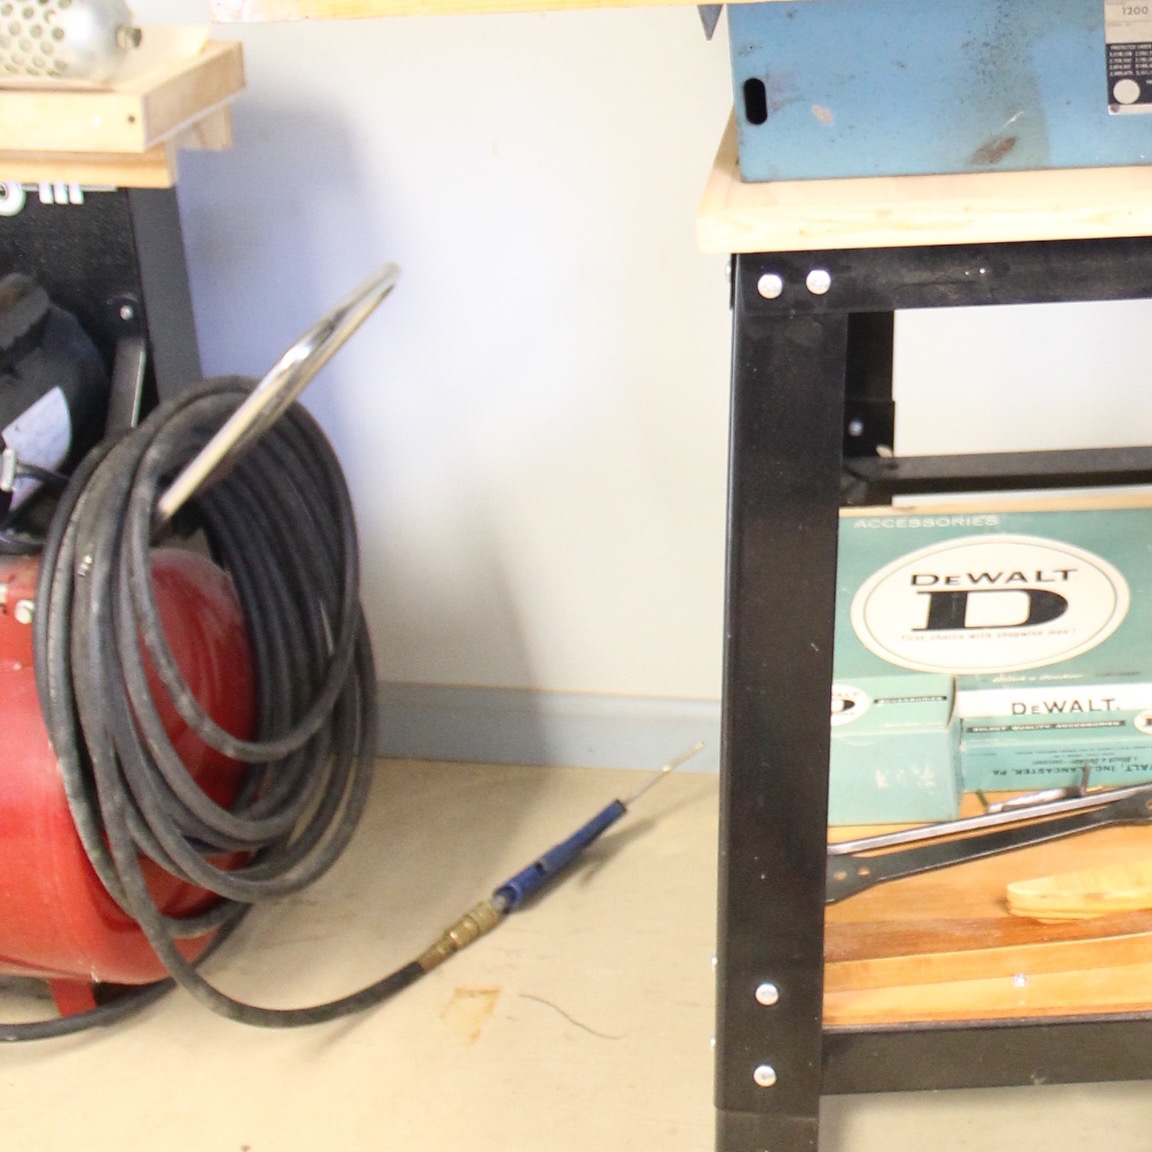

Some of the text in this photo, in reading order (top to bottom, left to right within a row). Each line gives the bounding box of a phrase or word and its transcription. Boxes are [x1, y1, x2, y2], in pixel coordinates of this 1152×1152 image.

[1121, 6, 1149, 16] 1200
[853, 515, 1001, 529] ACCESSORIES
[1011, 723, 1052, 731] QUALITY
[1056, 720, 1121, 729] ACCESSORIES
